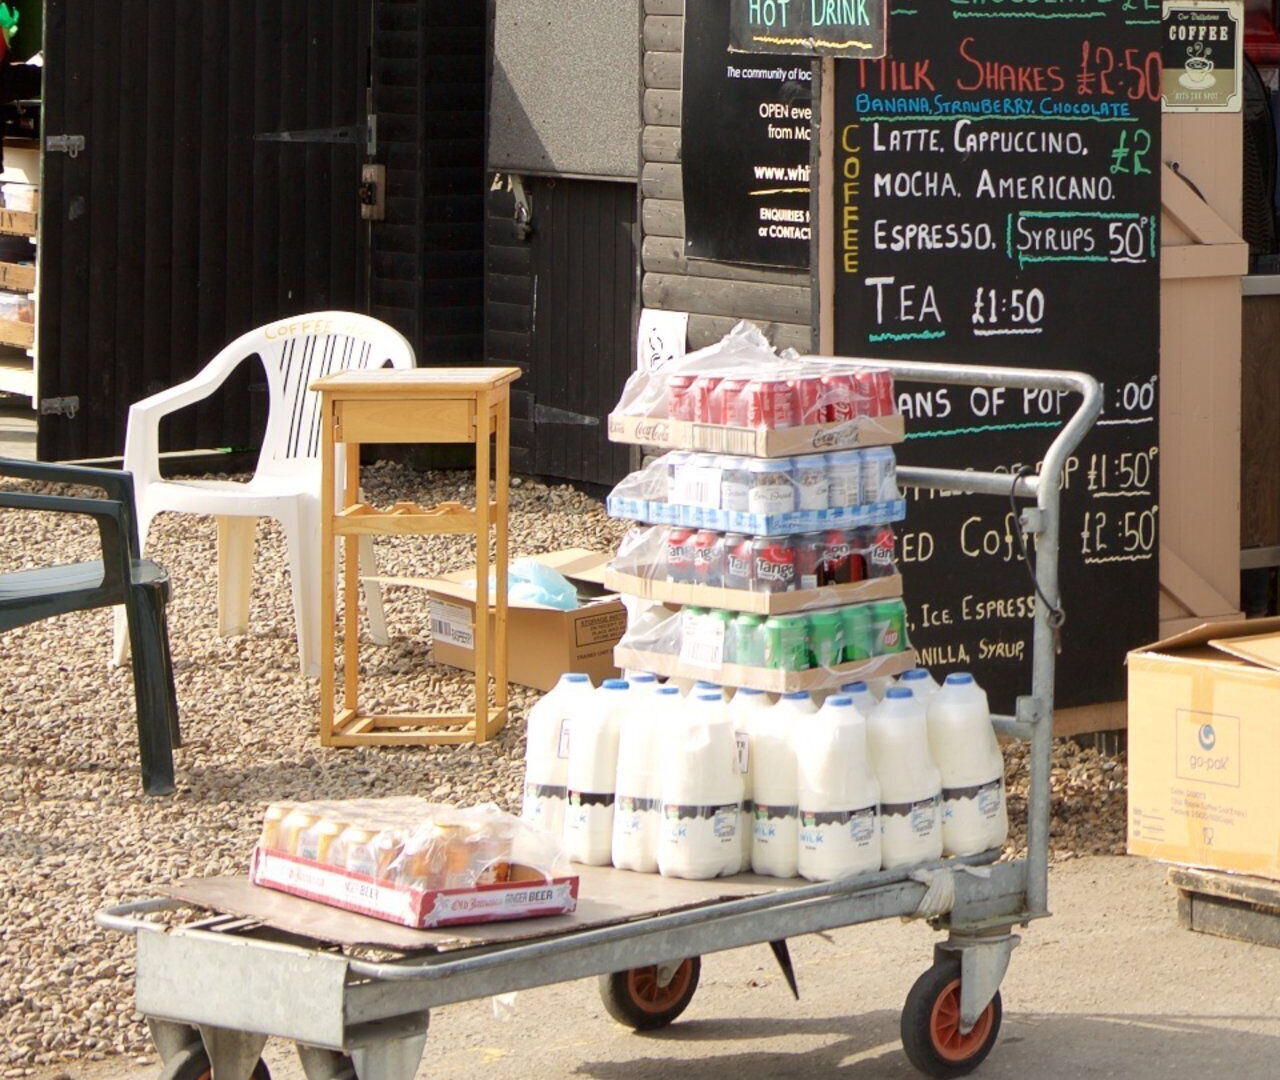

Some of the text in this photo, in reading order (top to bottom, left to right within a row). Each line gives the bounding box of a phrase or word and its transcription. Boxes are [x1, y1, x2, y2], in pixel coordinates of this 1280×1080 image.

[1168, 25, 1229, 41] COFFEE
[727, 66, 797, 83] The community of
[957, 37, 1065, 92] SHAKES
[1077, 40, 1163, 100] £2:50
[759, 103, 789, 119] OPEN
[1039, 97, 1130, 117] CHOCOLATE
[768, 124, 792, 139] from
[1109, 129, 1152, 174] £2
[842, 124, 860, 273] COFFEE
[760, 208, 804, 223] ENQUIRIES
[758, 227, 768, 238] or
[1017, 217, 1095, 251] SYRUPS
[865, 276, 1045, 324] TEA £1:50
[970, 386, 1006, 417] OF
[528, 890, 553, 902] BEER
